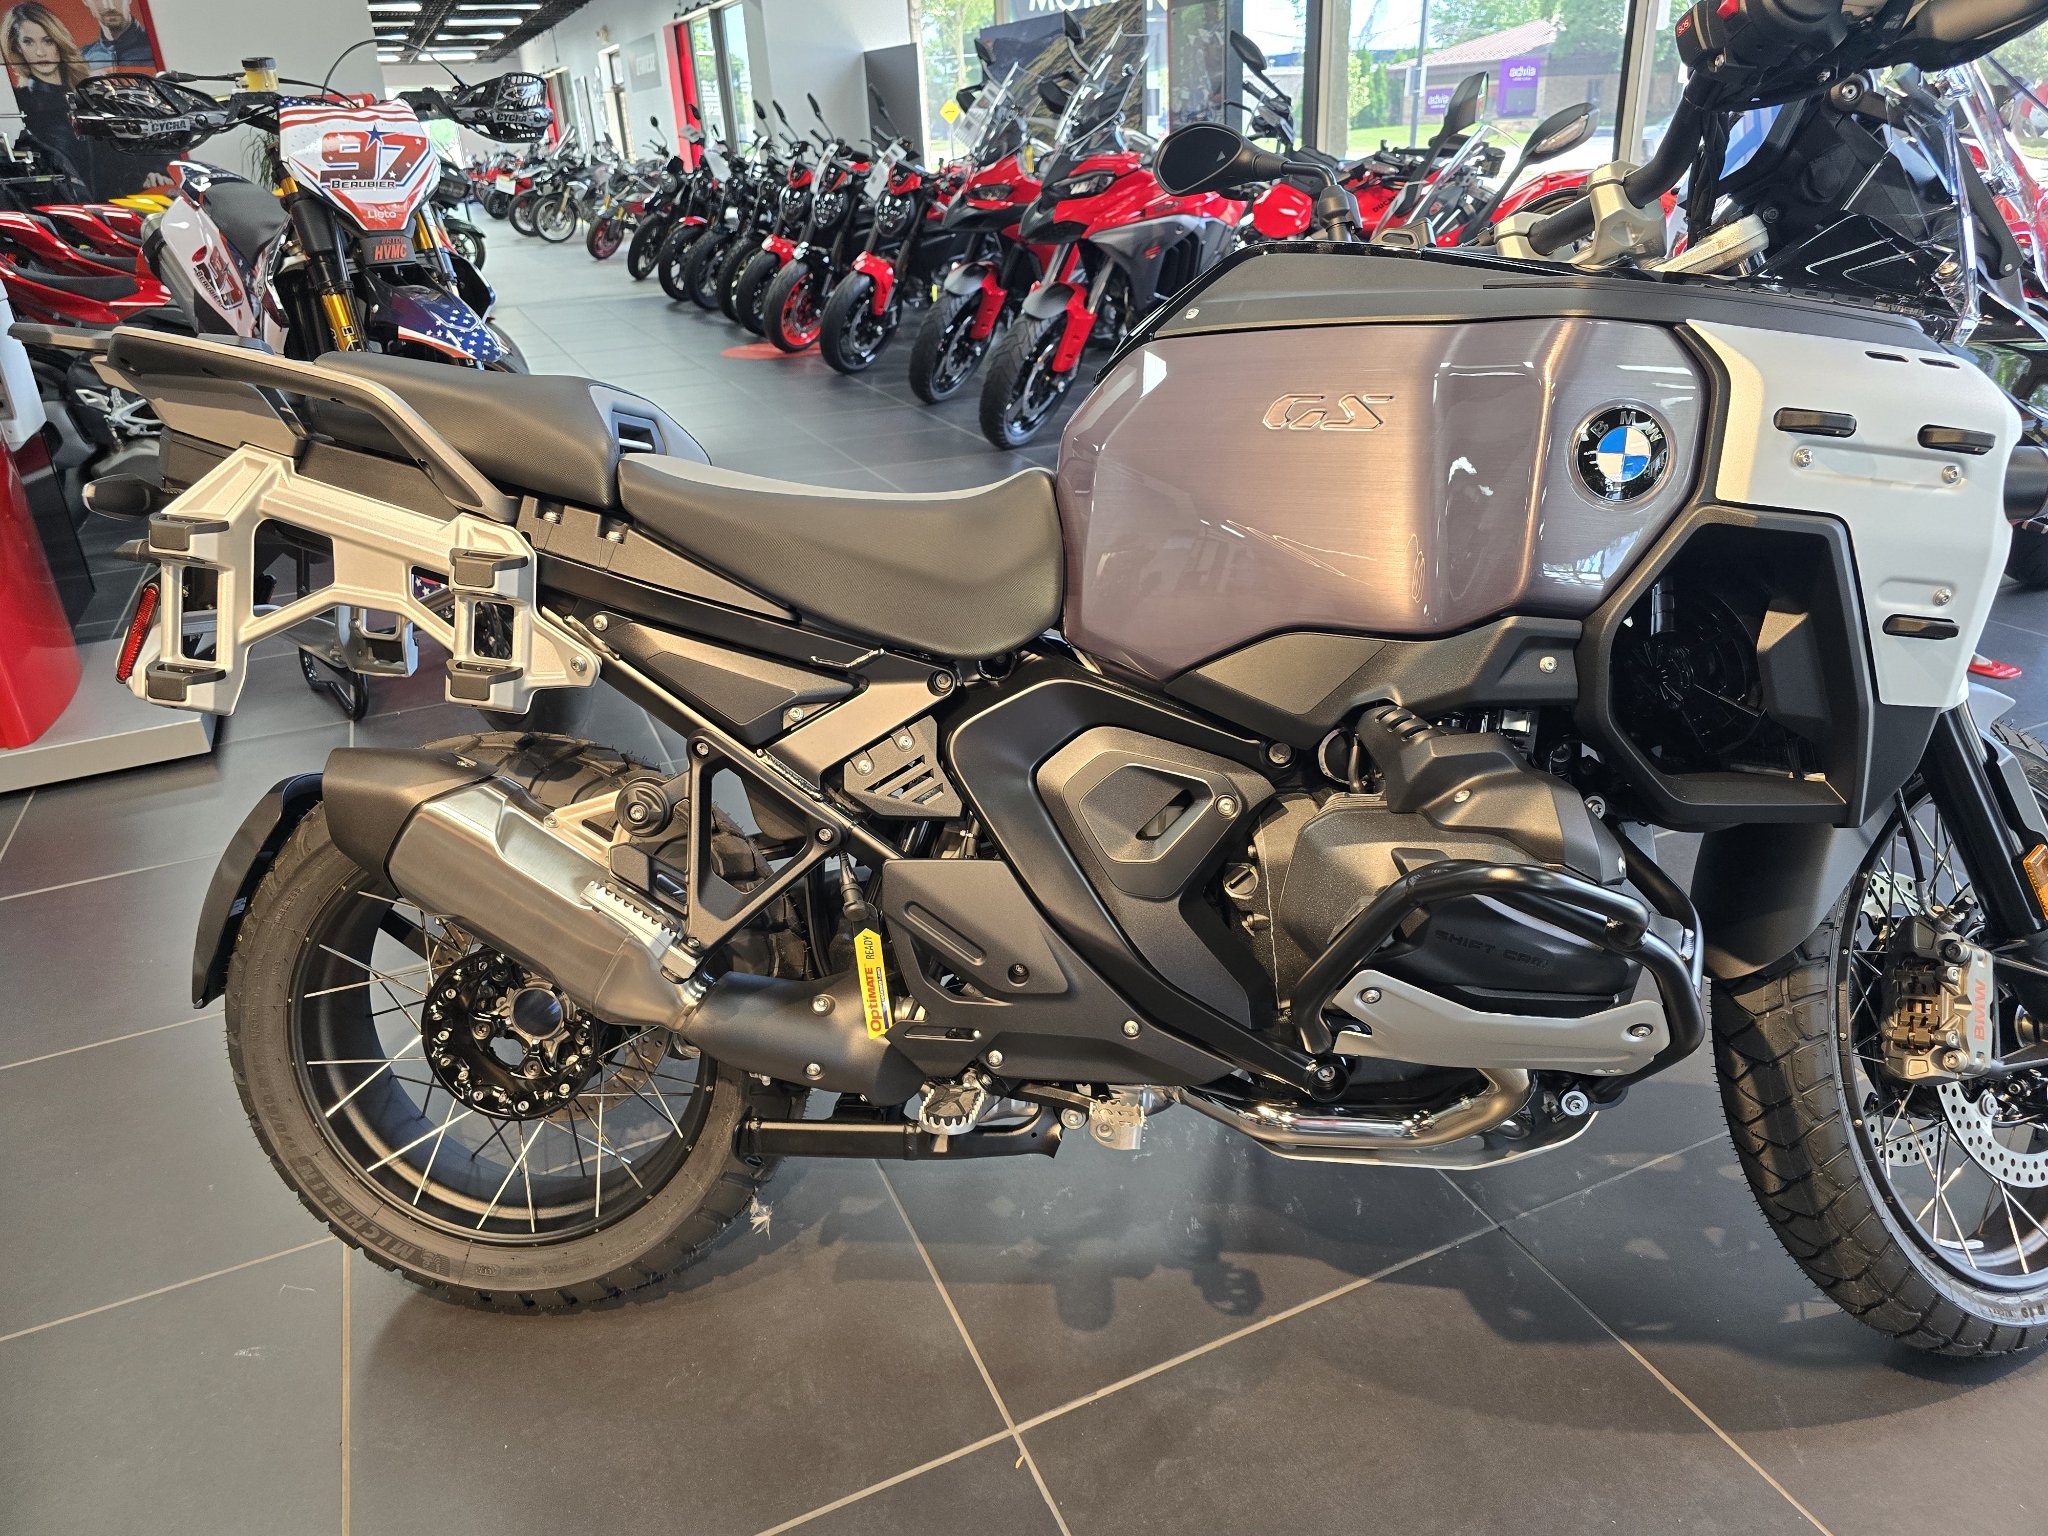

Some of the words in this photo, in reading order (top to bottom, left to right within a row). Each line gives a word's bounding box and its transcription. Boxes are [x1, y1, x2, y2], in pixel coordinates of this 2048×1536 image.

[1678, 18, 1689, 34] SOS
[320, 131, 431, 186] 97
[375, 243, 408, 261] HVMC
[1262, 393, 1395, 432] GS
[1589, 410, 1664, 443] BMW
[863, 935, 876, 960] READY
[1435, 929, 1496, 954] SHIFT
[865, 967, 883, 1033] OptiMATE
[1974, 978, 1986, 1041] BMW
[299, 1160, 416, 1260] MICHELIN
